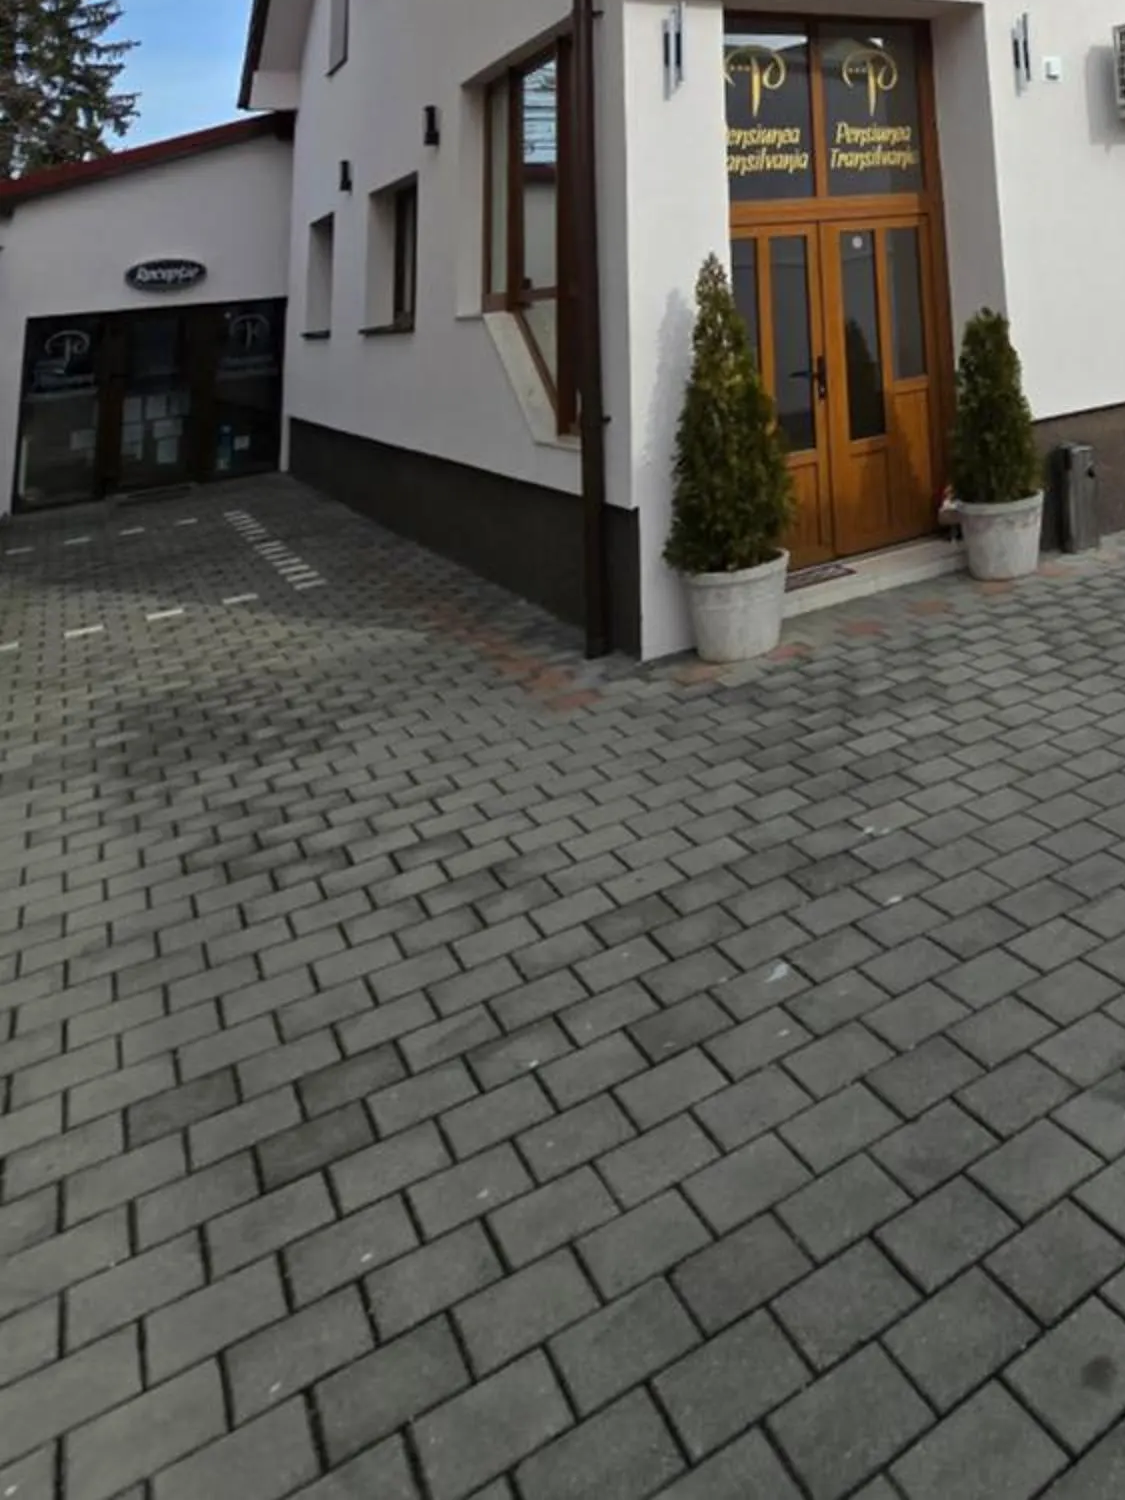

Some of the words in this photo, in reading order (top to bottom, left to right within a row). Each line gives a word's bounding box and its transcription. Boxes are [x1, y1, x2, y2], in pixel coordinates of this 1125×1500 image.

[727, 125, 800, 148] ensiunea
[836, 121, 911, 146] Pensiunea
[726, 148, 808, 176] ansilvania
